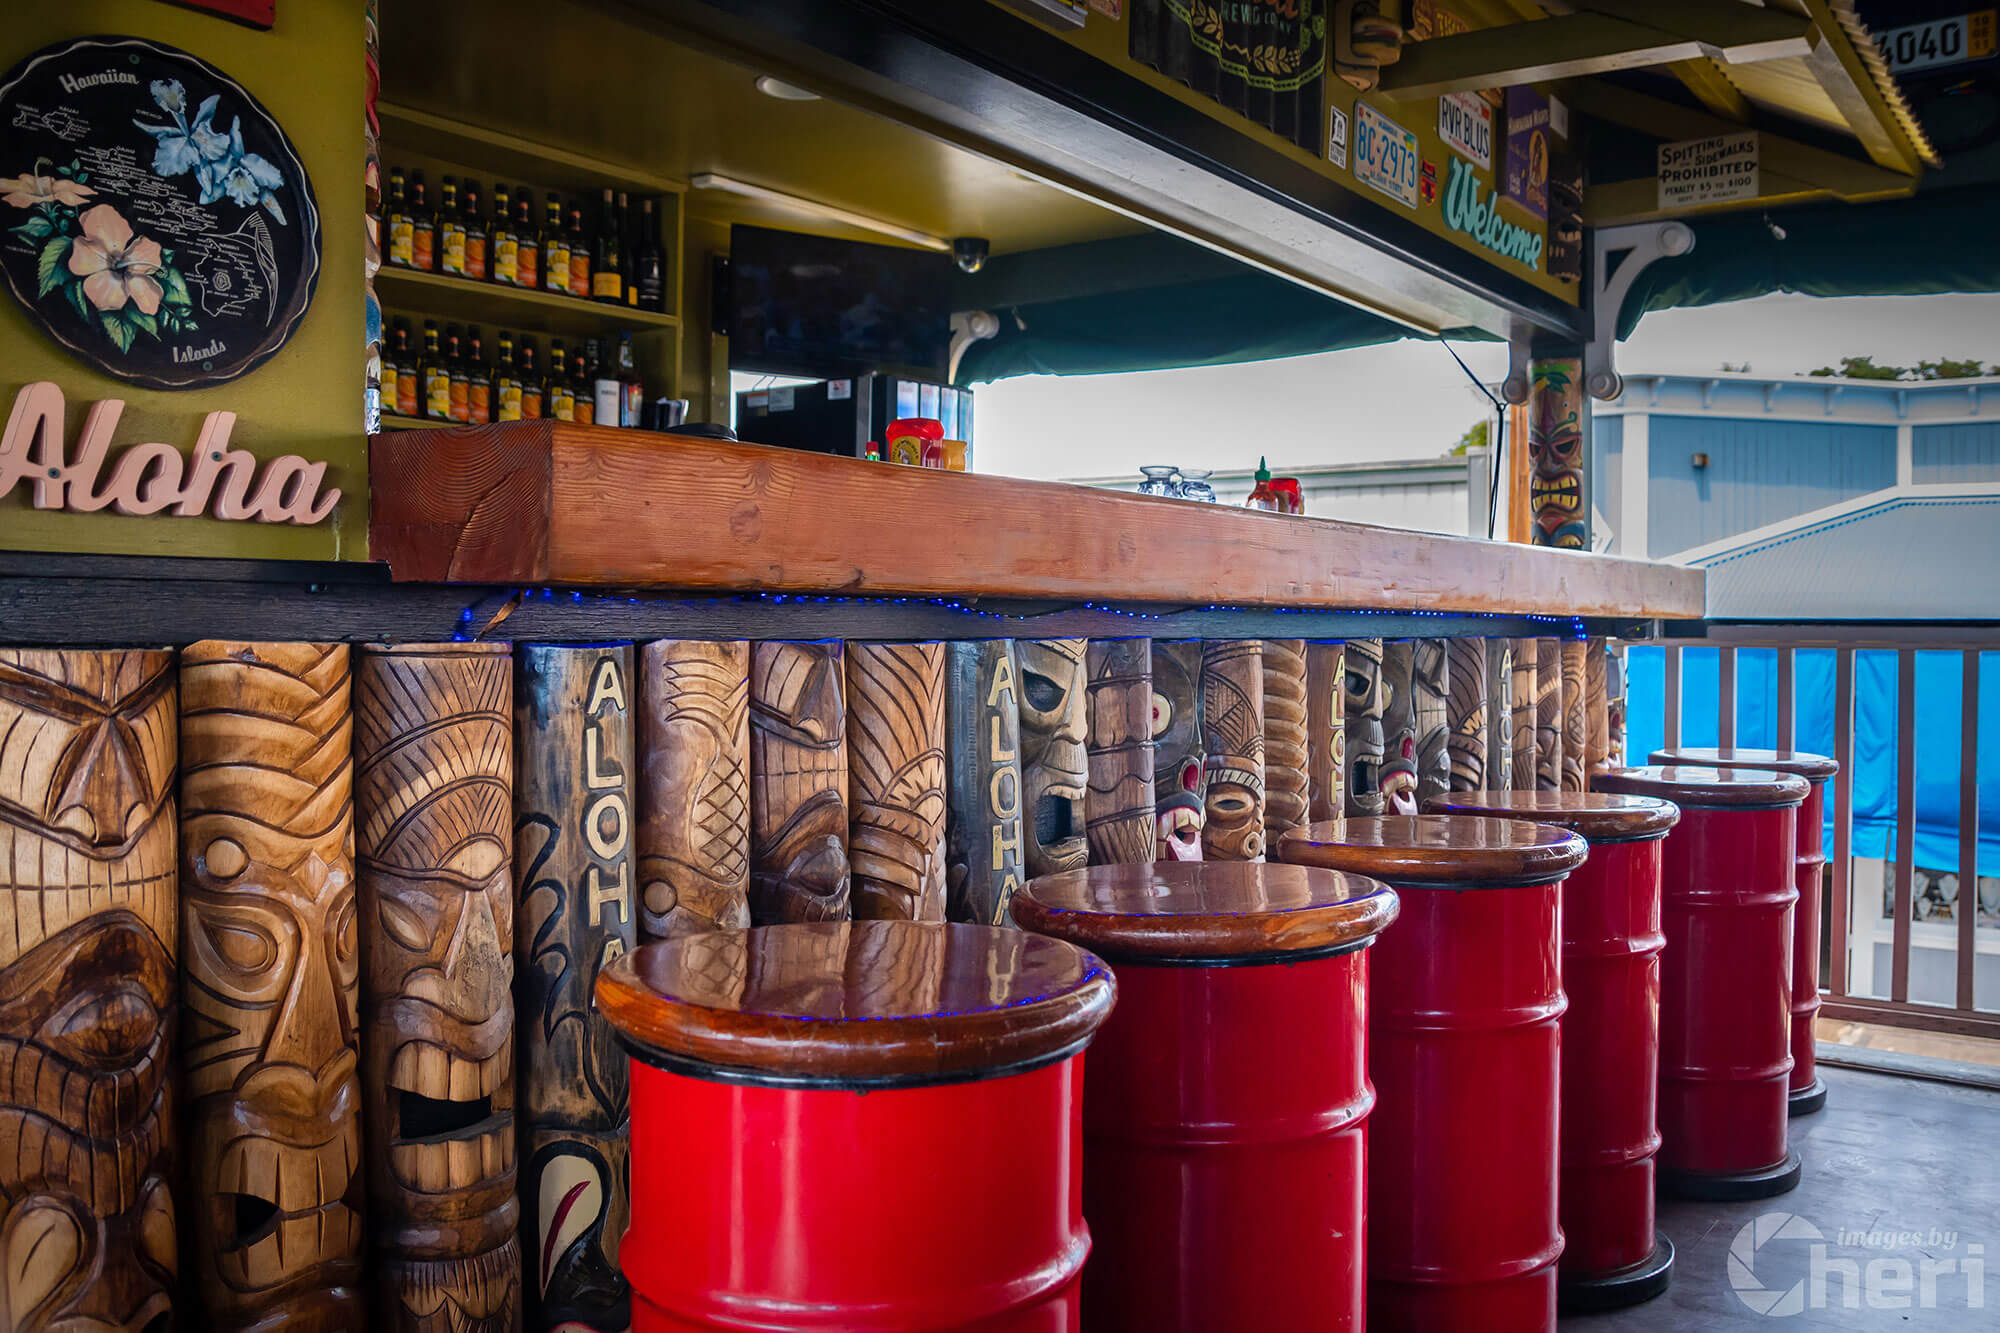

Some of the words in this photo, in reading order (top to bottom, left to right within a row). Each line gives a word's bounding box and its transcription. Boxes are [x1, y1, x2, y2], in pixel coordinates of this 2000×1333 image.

[58, 68, 140, 94] Hawaiian
[1442, 96, 1462, 141] RVR
[1464, 112, 1489, 158] BLUS
[1358, 121, 1415, 188] 8C-2973
[1661, 137, 1724, 166] SPITTING
[1695, 140, 1754, 166] SIDEWALKS
[1659, 160, 1757, 183] PROHIBITED
[1665, 184, 1695, 196] PENALTY
[1728, 175, 1752, 187] $100
[1443, 155, 1542, 272] Welcome
[172, 338, 226, 363] Islands
[0, 380, 342, 525] Aloha
[1330, 654, 1345, 820] ALOH
